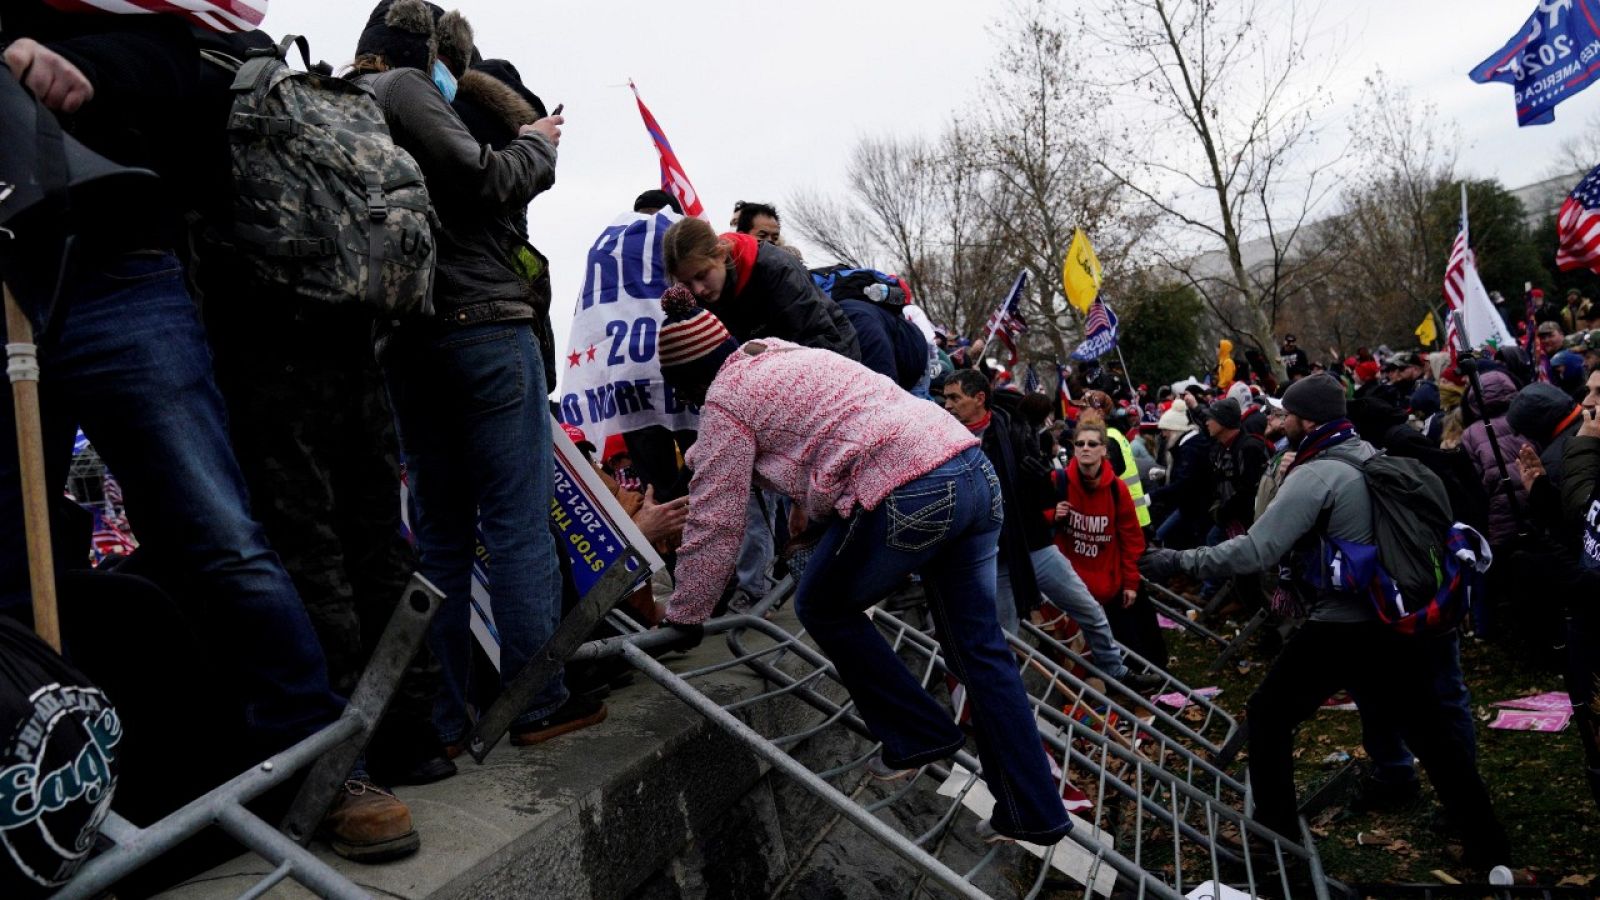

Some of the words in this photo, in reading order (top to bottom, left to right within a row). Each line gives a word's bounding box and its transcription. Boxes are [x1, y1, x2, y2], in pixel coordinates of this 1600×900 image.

[606, 317, 658, 366] 20
[558, 392, 584, 427] O
[585, 379, 656, 423] MORE
[554, 466, 602, 533] 2021-20
[1069, 509, 1109, 533] TRUMP
[569, 532, 605, 572] STOP
[1074, 539, 1098, 558] 2020
